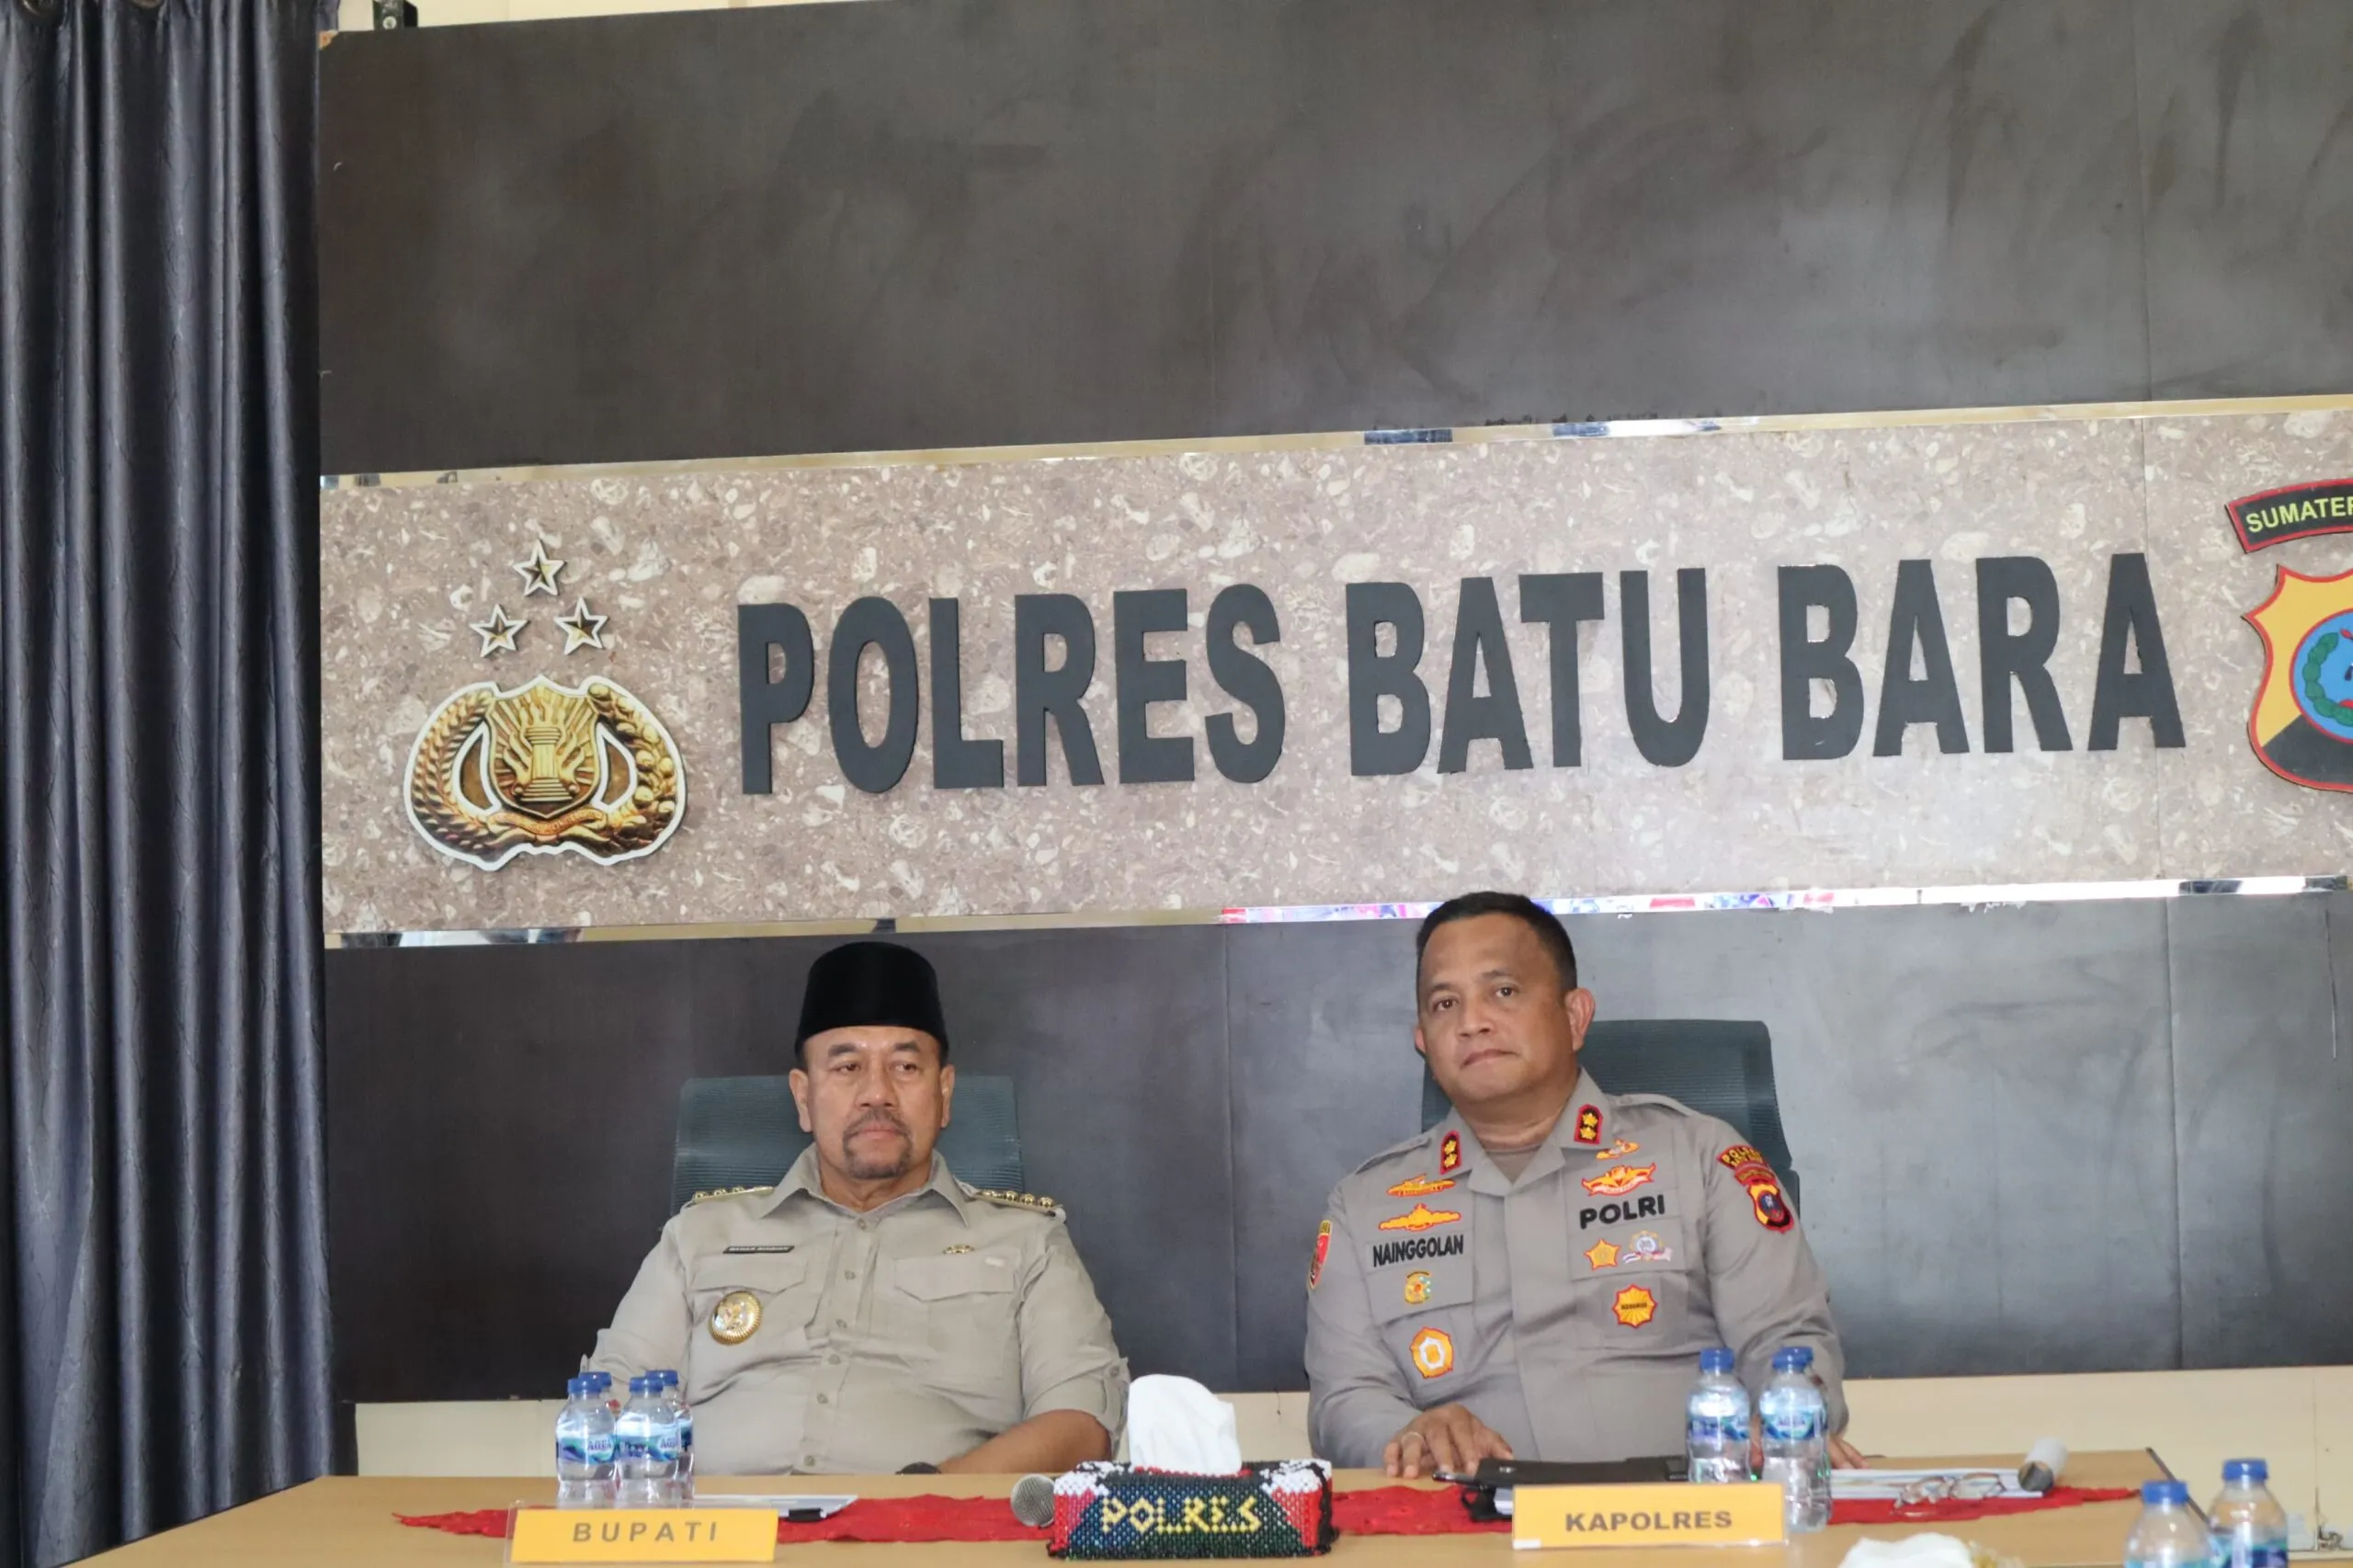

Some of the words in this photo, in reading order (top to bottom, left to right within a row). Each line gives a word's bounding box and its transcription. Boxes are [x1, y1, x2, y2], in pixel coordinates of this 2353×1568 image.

[737, 584, 1286, 794] POLRES
[1346, 567, 1711, 777] BATU
[1778, 553, 2187, 761] BARA
[1580, 1194, 1665, 1230] POLRI
[1373, 1233, 1464, 1267] NAINGGOLAN
[573, 1521, 718, 1543] BUPATI
[1103, 1496, 1261, 1534] POLRES
[1565, 1511, 1733, 1532] KAPOLRES
